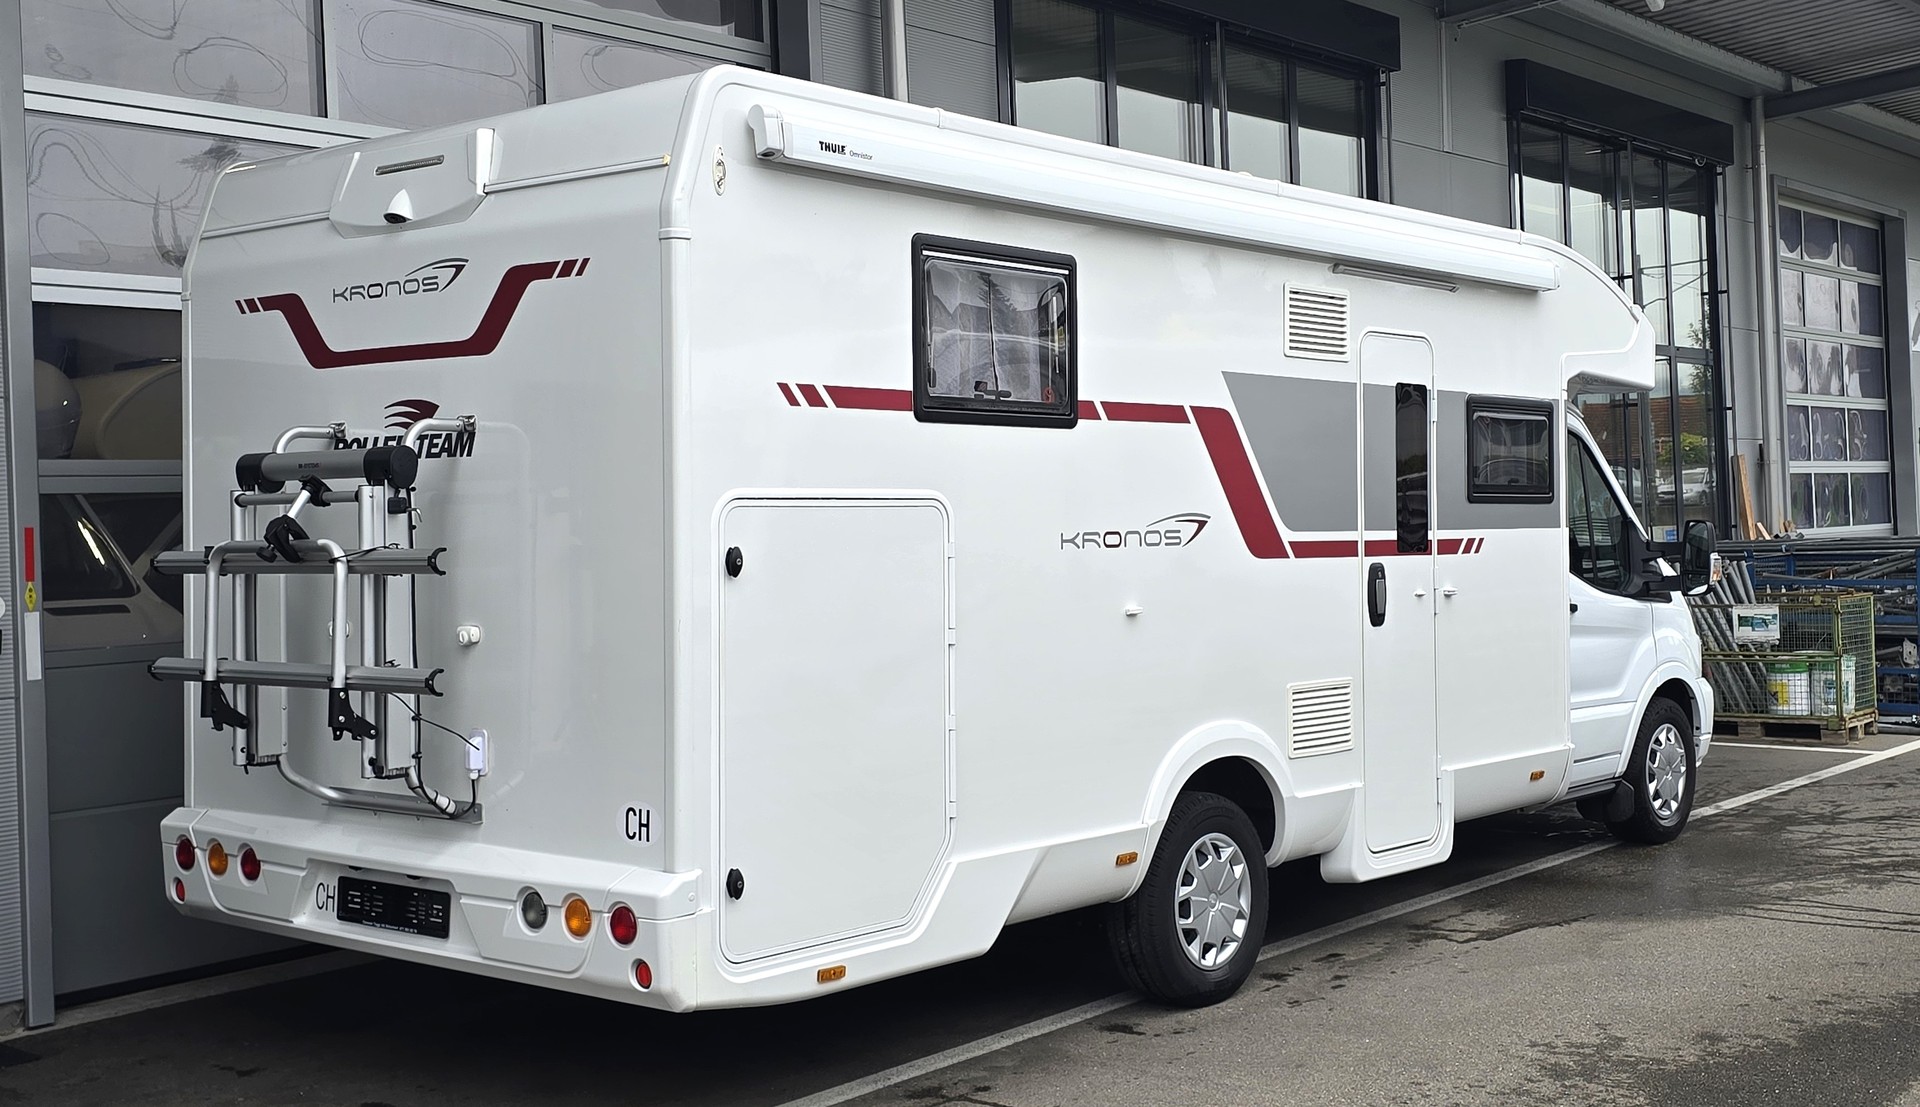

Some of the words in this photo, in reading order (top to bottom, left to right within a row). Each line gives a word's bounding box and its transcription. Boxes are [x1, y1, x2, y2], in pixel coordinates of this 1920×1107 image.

[819, 141, 846, 155] THULE
[333, 275, 439, 303] KRONOS
[415, 431, 476, 459] TEAM
[1060, 529, 1182, 550] KRONOS
[625, 806, 651, 843] CH
[315, 882, 336, 913] CH
